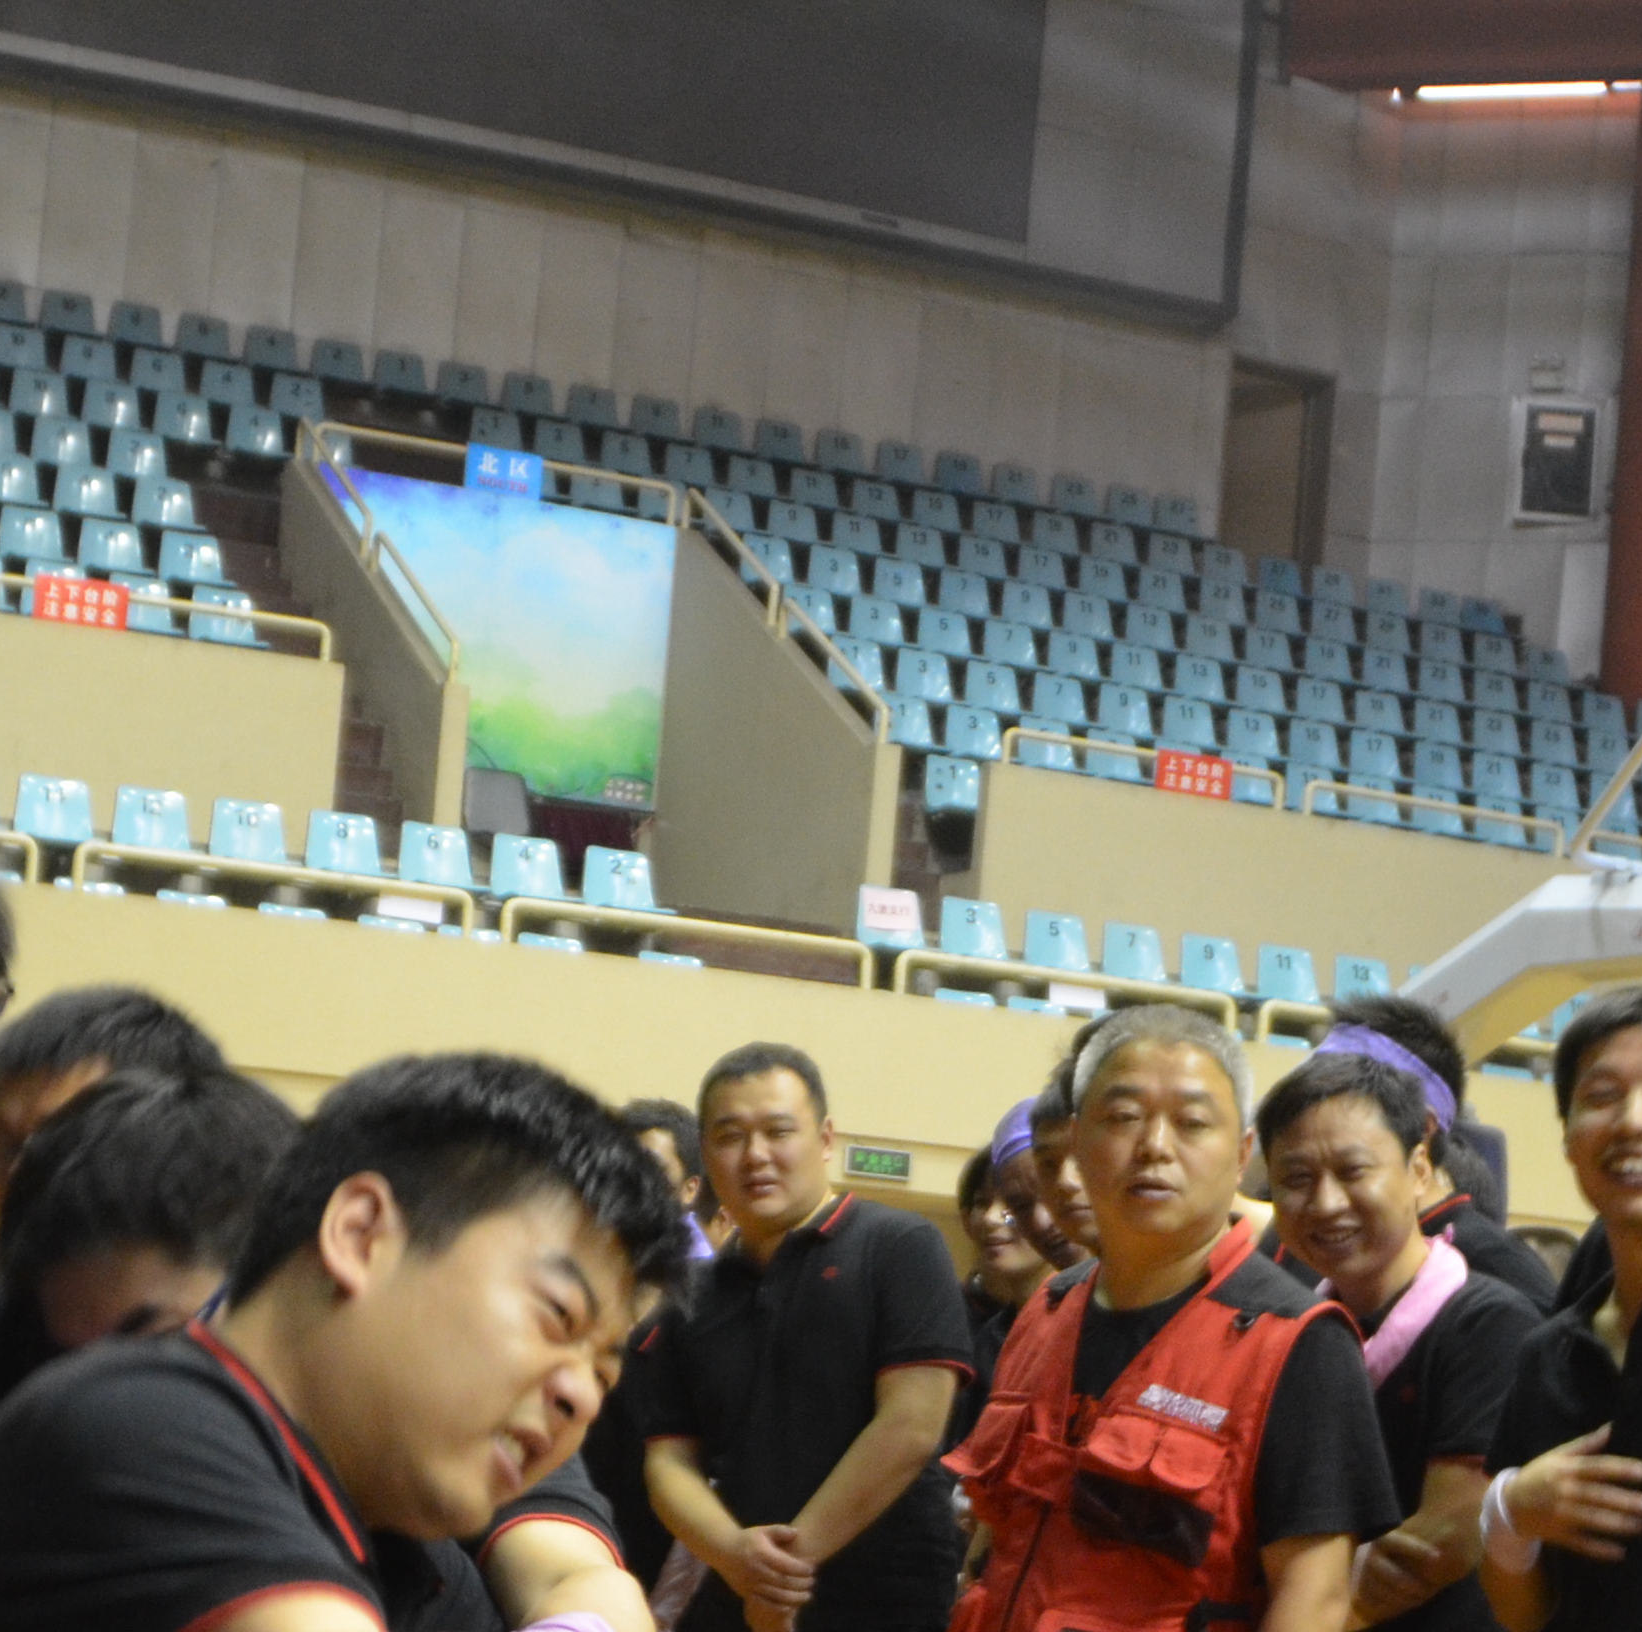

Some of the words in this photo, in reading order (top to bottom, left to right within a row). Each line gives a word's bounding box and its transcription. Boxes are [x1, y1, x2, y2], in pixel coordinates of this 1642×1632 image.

[477, 451, 529, 479] 北区
[911, 530, 928, 545] 13
[829, 558, 839, 573] 3
[892, 572, 903, 587] 5
[961, 578, 968, 591] 7
[45, 584, 119, 605] 上下台阶
[804, 593, 812, 607] 1
[1020, 589, 1031, 603] 9
[43, 600, 116, 625] 注意安全
[870, 606, 880, 621] 3
[1079, 599, 1093, 613] 11
[938, 617, 949, 631] 5
[1141, 612, 1158, 627] 13
[1005, 628, 1014, 641] 7
[1259, 634, 1276, 648] 17
[1067, 640, 1078, 654] 9
[1126, 650, 1141, 665] 11
[1376, 655, 1390, 668] 21
[918, 658, 928, 673] 3
[1191, 662, 1208, 677] 13
[986, 670, 997, 685] 5
[1055, 681, 1064, 696] 7
[1311, 684, 1327, 699] 17
[1119, 692, 1129, 707] 9
[898, 703, 906, 716] 1
[1179, 704, 1194, 719] 11
[1428, 706, 1443, 721] 21
[968, 715, 978, 730] 3
[1243, 716, 1260, 732] 13
[1486, 716, 1503, 732] 23
[1366, 737, 1383, 751] 17
[948, 764, 957, 779] 1
[1165, 756, 1224, 777] 上下台阶
[1486, 759, 1501, 774] 21
[1163, 773, 1223, 795] 注意安全
[1544, 770, 1561, 786] 23
[237, 809, 259, 827] 10
[335, 822, 349, 840] 8
[426, 834, 440, 851] 6
[518, 845, 532, 861] 4
[609, 859, 623, 875] 2
[965, 907, 977, 925] 3
[1048, 920, 1060, 938] 5
[1127, 931, 1137, 948] 7
[1203, 943, 1215, 961] 9
[1275, 953, 1292, 970] 11
[1351, 964, 1370, 982] 13
